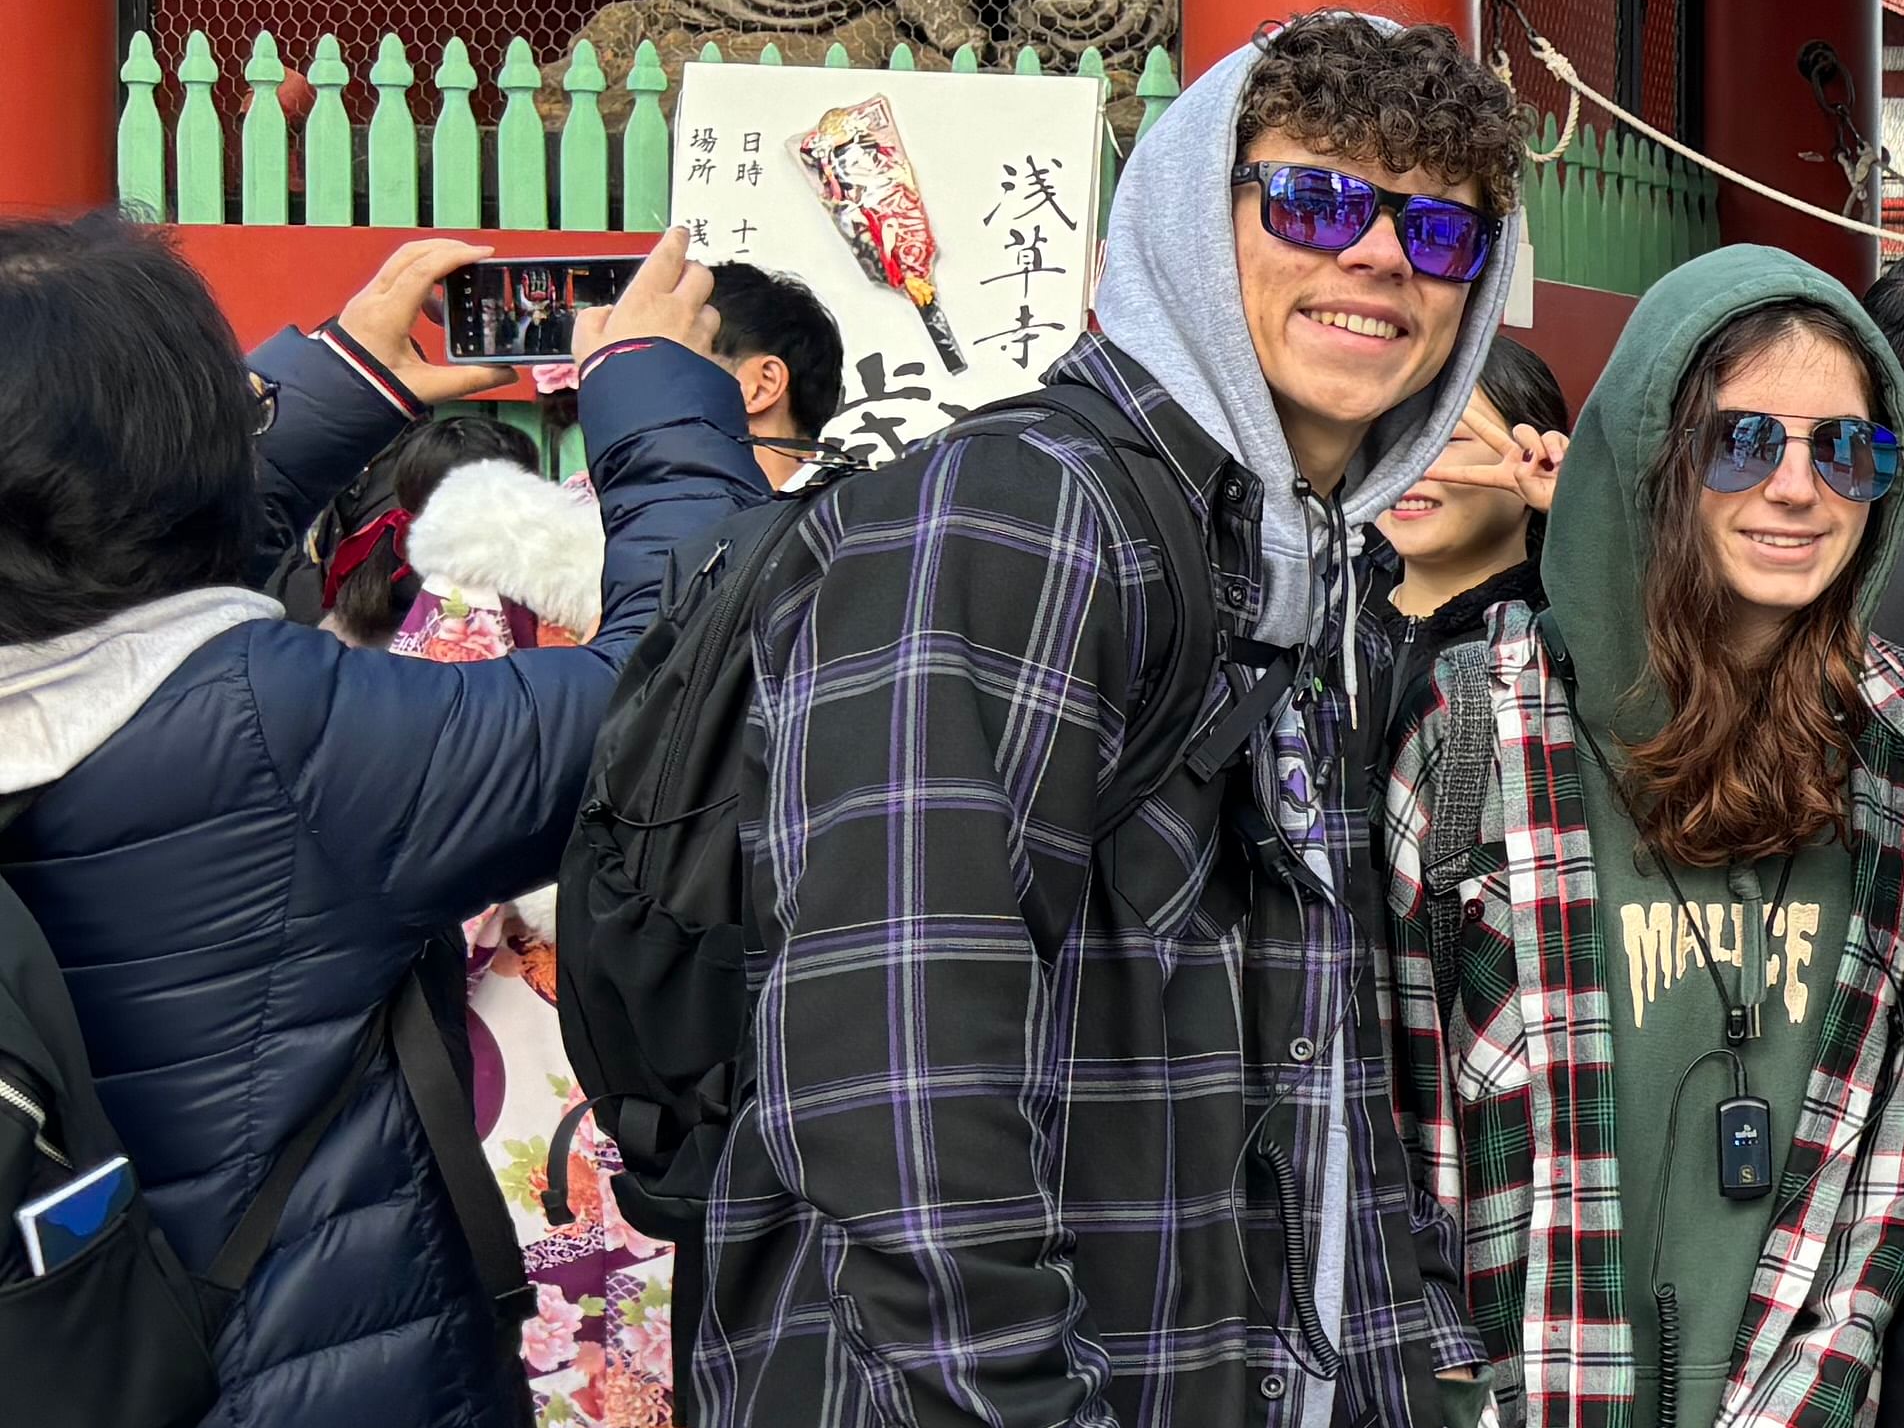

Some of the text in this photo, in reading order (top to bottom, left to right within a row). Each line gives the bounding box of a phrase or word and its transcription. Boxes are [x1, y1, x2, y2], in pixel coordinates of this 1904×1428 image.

[687, 128, 718, 185] 場所
[735, 131, 763, 184] 日時
[973, 154, 1077, 368] 浅草寺
